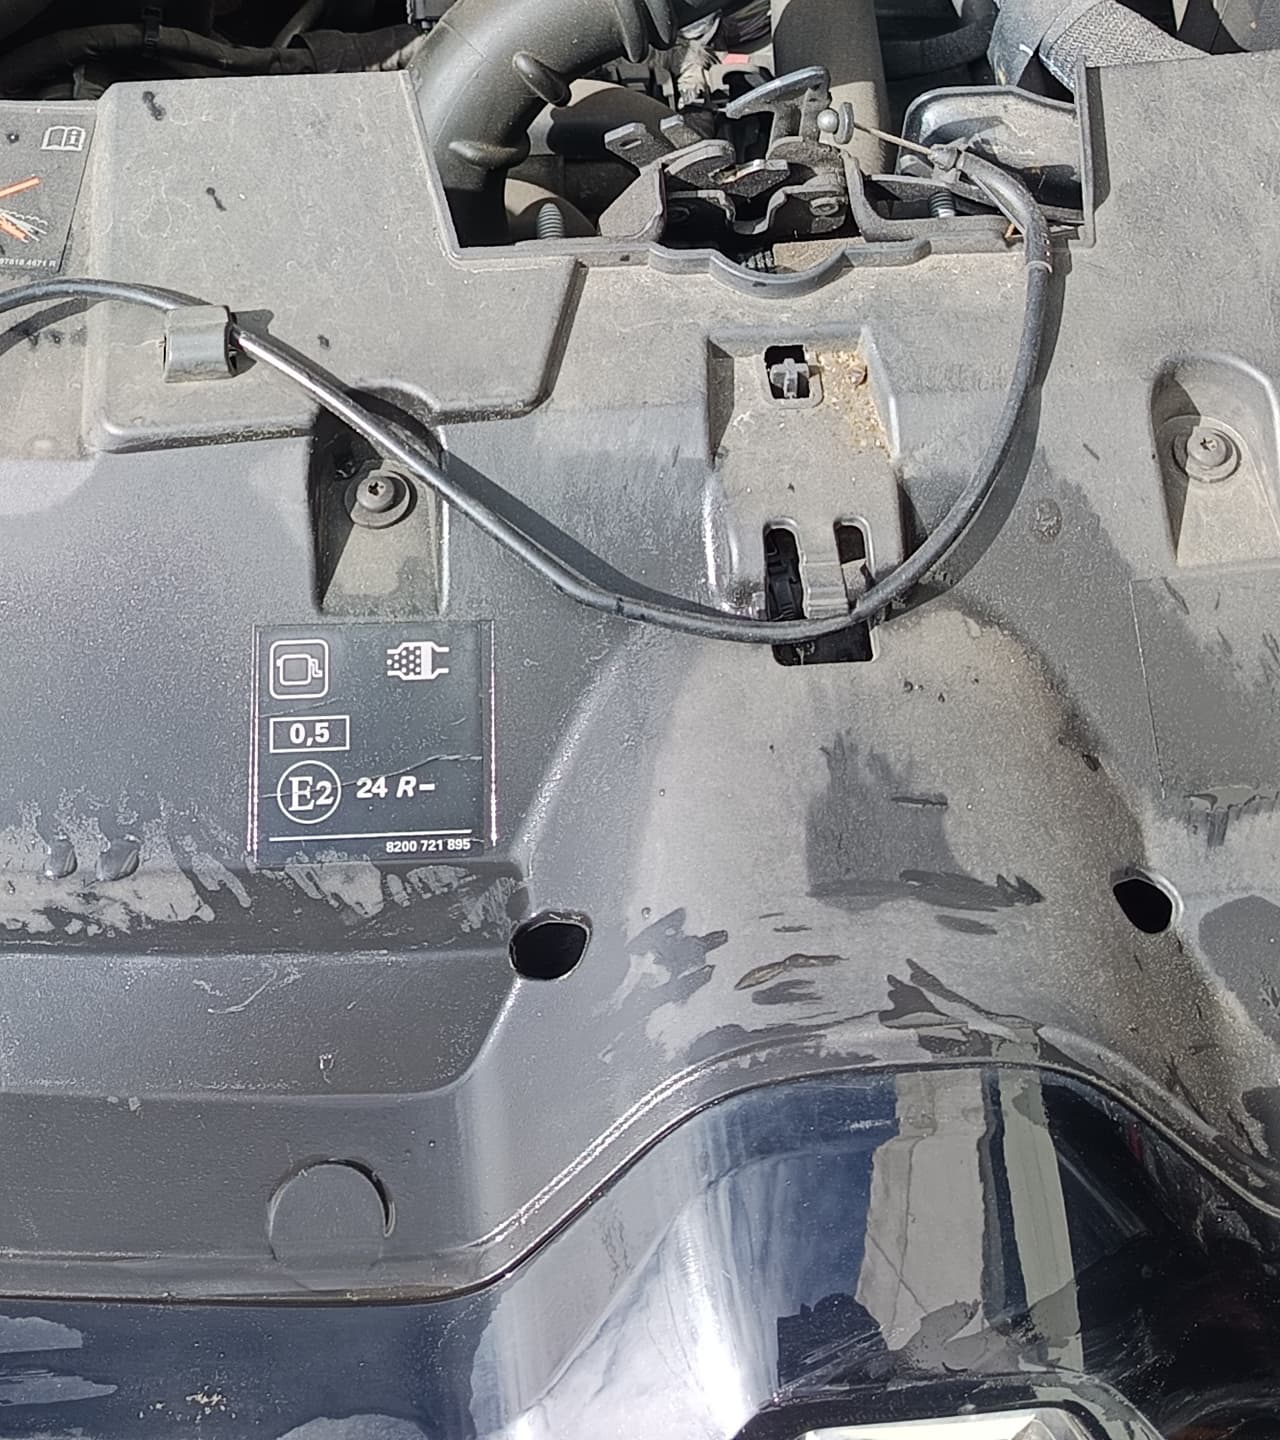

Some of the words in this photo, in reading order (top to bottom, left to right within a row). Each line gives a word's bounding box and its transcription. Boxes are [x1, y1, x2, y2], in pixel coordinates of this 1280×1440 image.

[289, 721, 331, 747] 0,5
[287, 775, 335, 812] E2
[356, 776, 389, 799] 24
[385, 840, 418, 853] 8200
[420, 839, 444, 852] 721
[447, 837, 472, 851] 895
